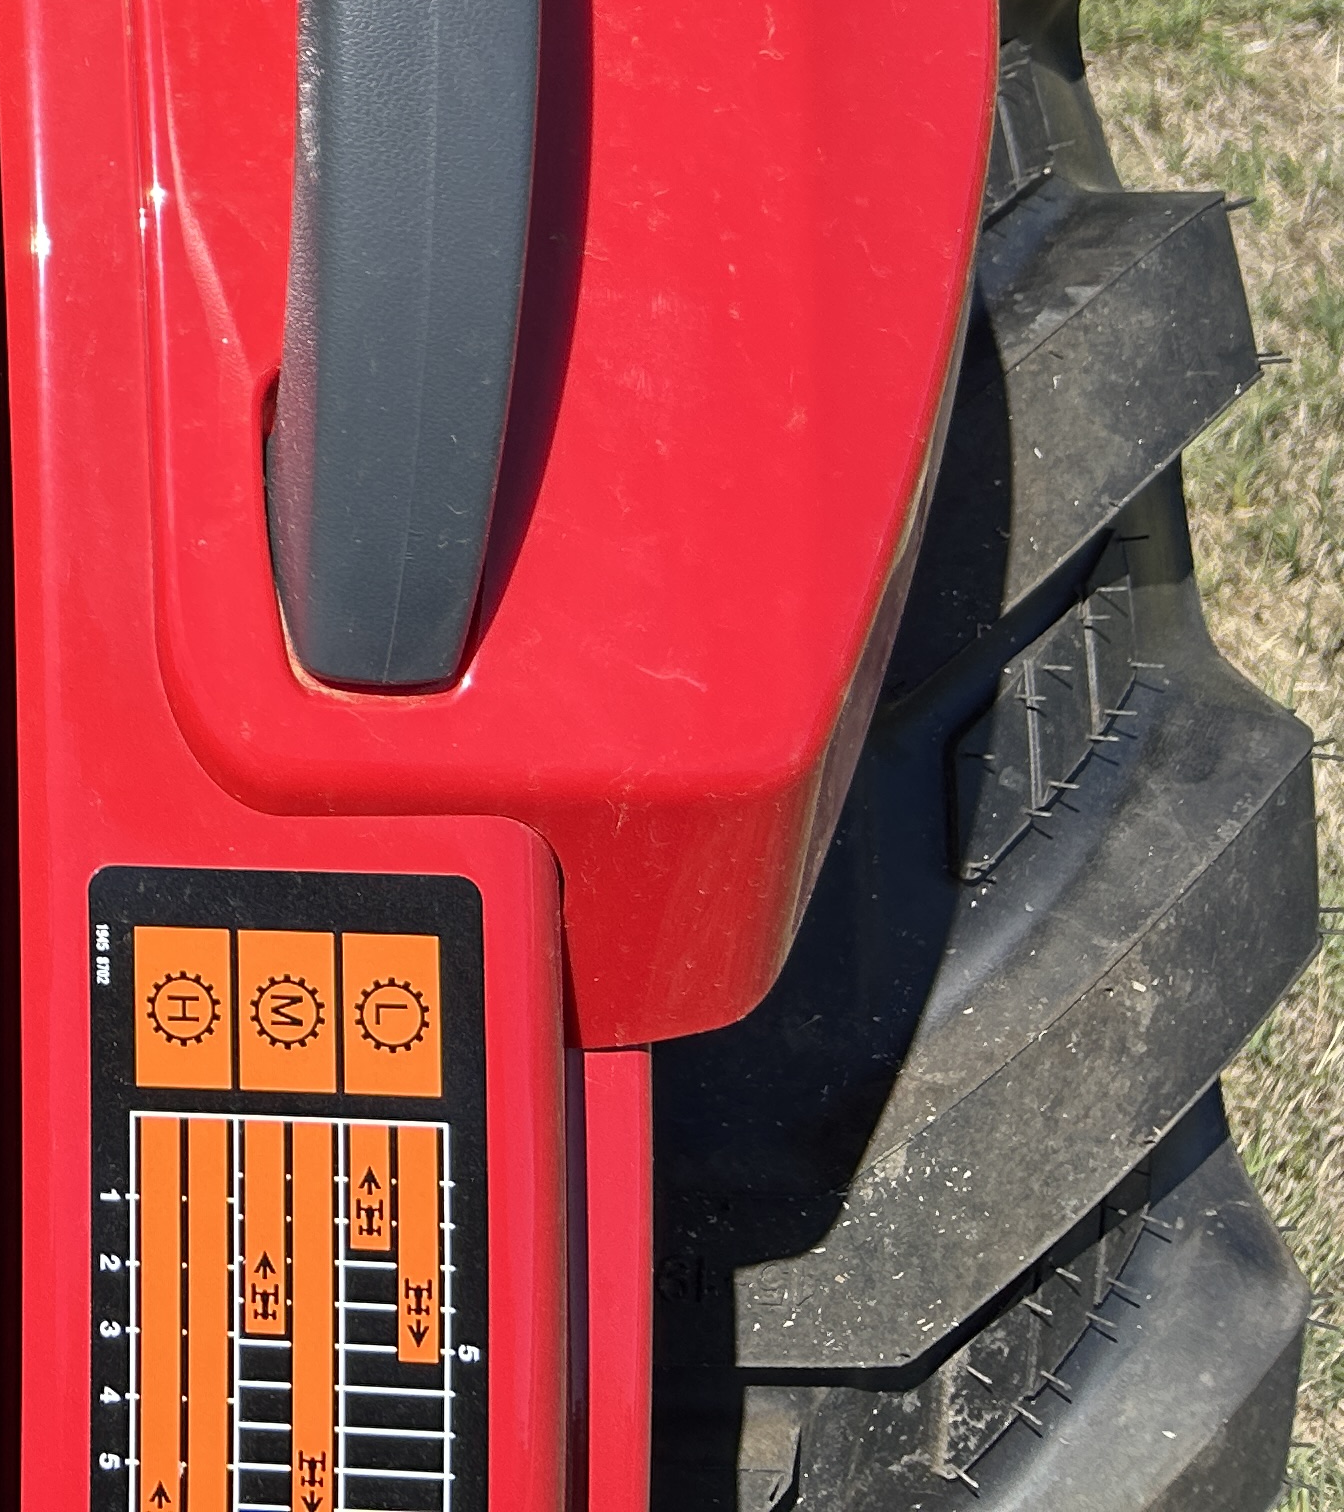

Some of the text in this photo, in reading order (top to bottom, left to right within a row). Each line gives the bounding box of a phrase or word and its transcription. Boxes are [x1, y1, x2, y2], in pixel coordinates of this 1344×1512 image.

[166, 994, 200, 1023] H
[269, 994, 304, 1027] M
[374, 1003, 409, 1026] L
[99, 1188, 121, 1205] 1
[99, 1254, 121, 1272] 2
[99, 1321, 121, 1338] 3
[457, 1344, 480, 1364] 5
[99, 1386, 121, 1404] 4
[99, 1453, 121, 1471] 5
